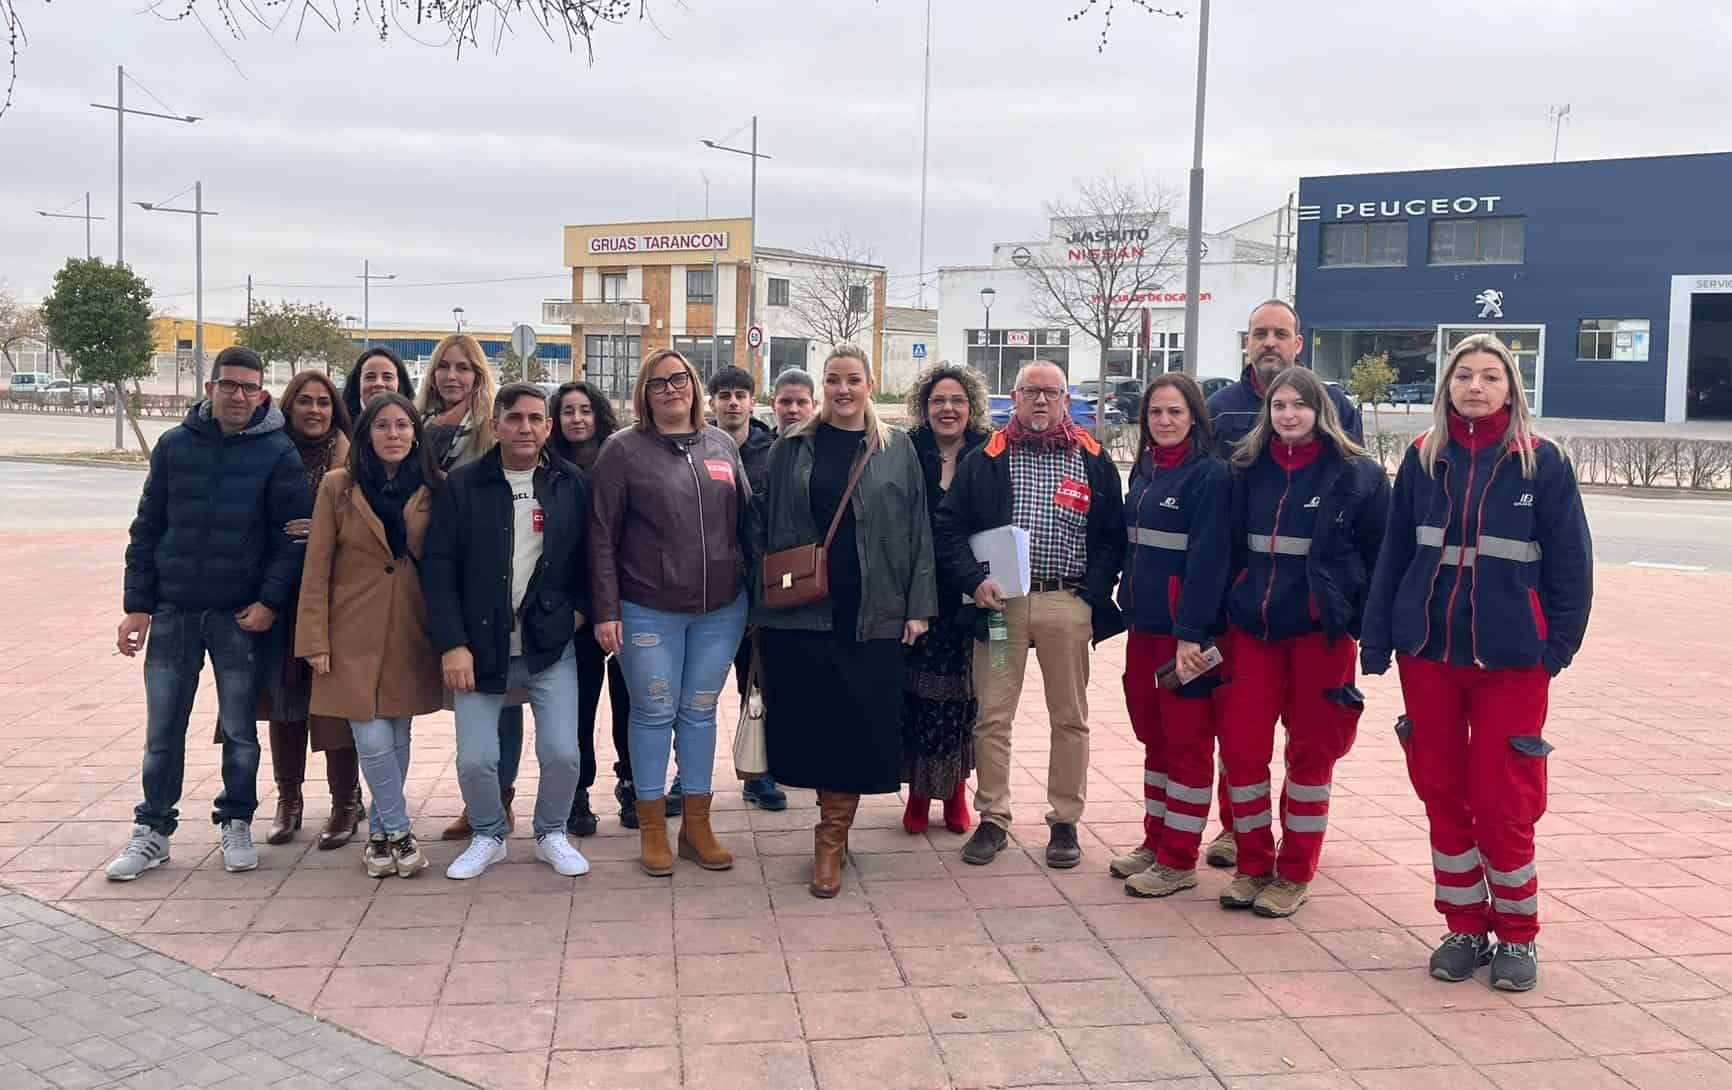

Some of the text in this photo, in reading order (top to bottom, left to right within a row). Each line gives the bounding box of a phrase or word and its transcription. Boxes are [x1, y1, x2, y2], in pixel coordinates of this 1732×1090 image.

[1336, 196, 1501, 218] PEUGEOT
[591, 234, 724, 251] GRUAS TARANCON
[1068, 247, 1144, 261] NISSAN
